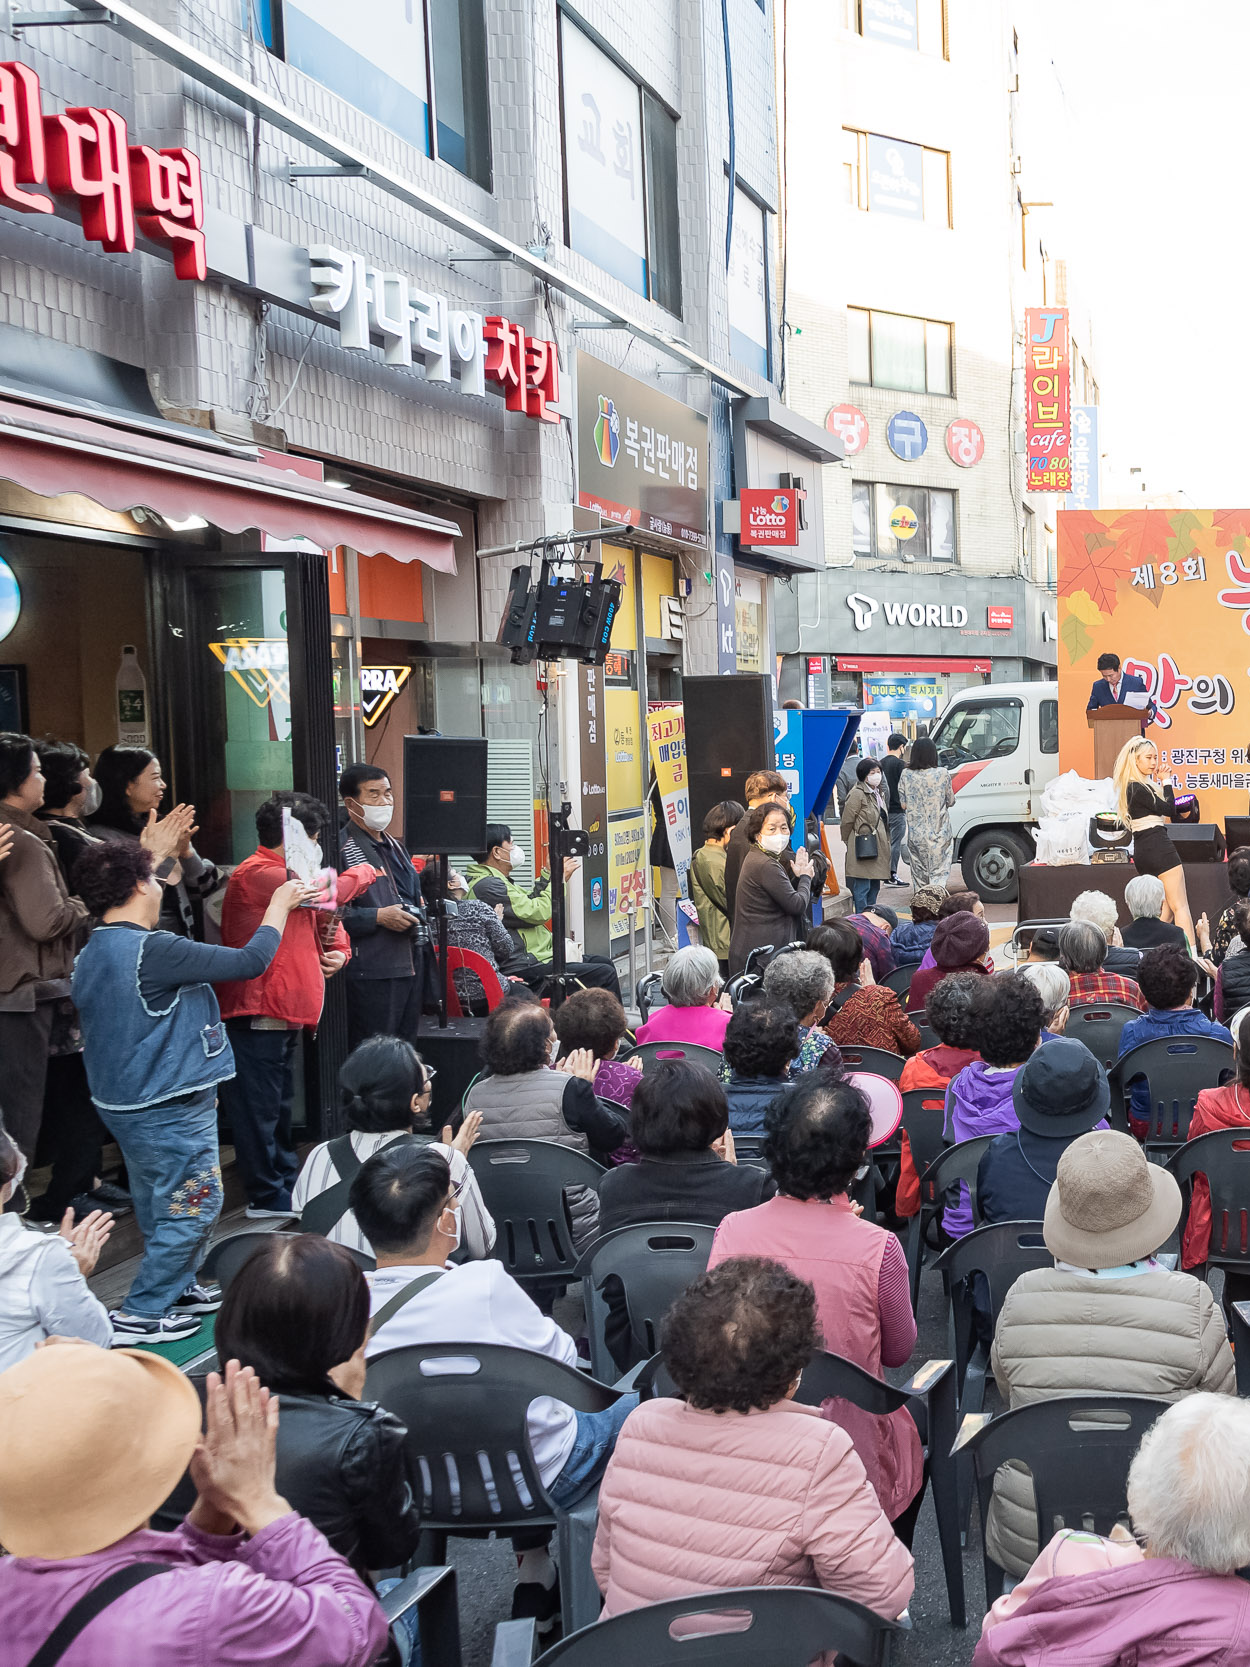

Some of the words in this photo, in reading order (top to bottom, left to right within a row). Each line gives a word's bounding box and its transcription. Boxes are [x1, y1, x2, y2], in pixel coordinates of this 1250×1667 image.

[1030, 429, 1067, 453] cafe
[624, 416, 698, 491] 복권판매점
[1029, 471, 1069, 487] 노래장
[749, 513, 786, 526] Lotto
[750, 529, 787, 539] 복권판매점
[1131, 556, 1208, 589] 제8회
[882, 602, 969, 628] WORLD
[721, 622, 734, 654] kt
[871, 685, 906, 696] 아이폰14
[586, 668, 597, 744] 판매점
[1171, 749, 1225, 764] 광진구청
[672, 763, 683, 782] 금
